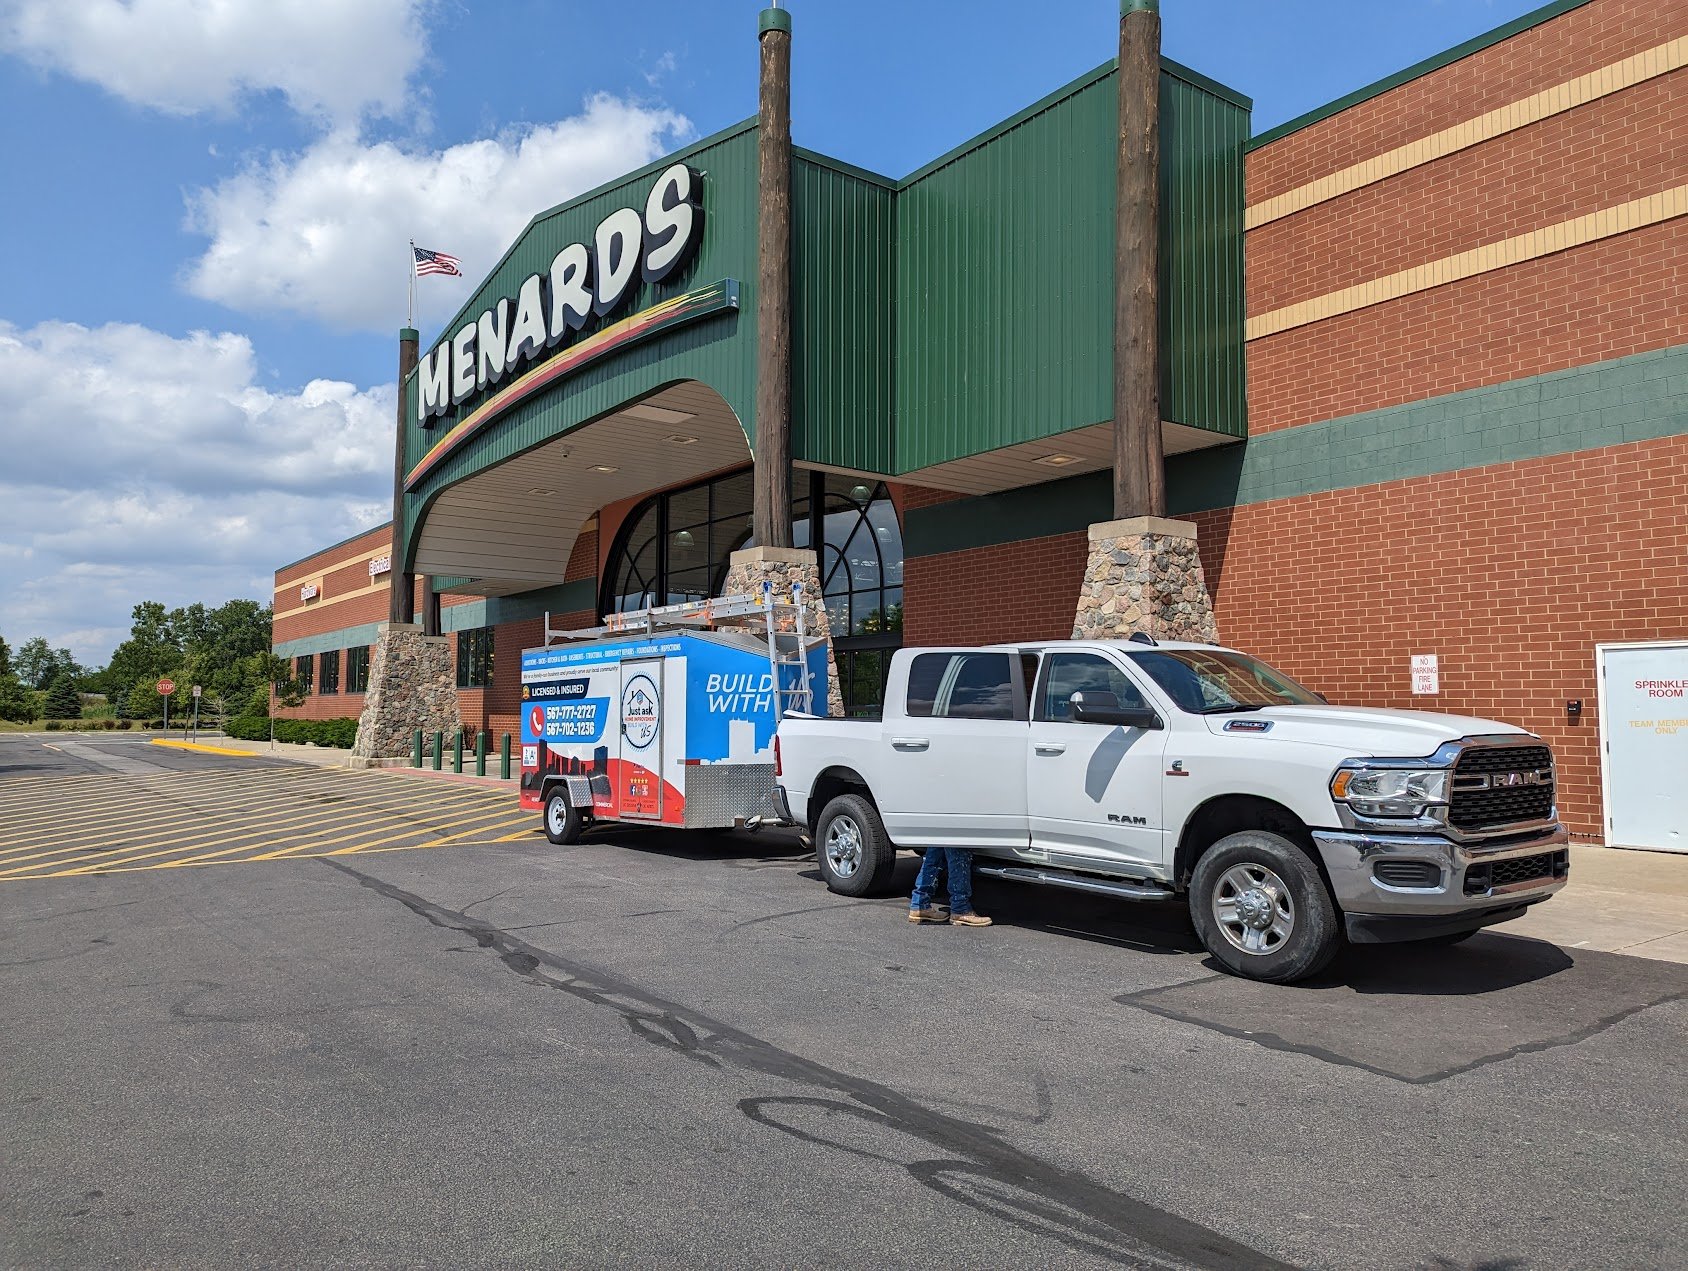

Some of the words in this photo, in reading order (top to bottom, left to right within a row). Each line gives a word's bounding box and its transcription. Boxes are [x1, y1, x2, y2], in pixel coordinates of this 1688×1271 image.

[418, 163, 703, 427] MENARDS
[1420, 657, 1428, 665] NO
[1413, 666, 1436, 674] PARKING
[706, 674, 774, 693] BUILD
[1417, 684, 1432, 692] LANE
[1635, 680, 1688, 689] SPRINKLE
[532, 686, 556, 696] LICENSED
[561, 685, 584, 694] INSURED
[1649, 689, 1683, 697] ROOM
[709, 693, 771, 713] WITH
[547, 705, 596, 719] 567-777-2727
[628, 706, 641, 716] Just
[547, 722, 595, 736] 567-702-1236
[1629, 720, 1654, 728] TEAM
[1655, 727, 1678, 735] ONLY
[1493, 772, 1538, 787] RAM
[1107, 813, 1147, 826] RAM
